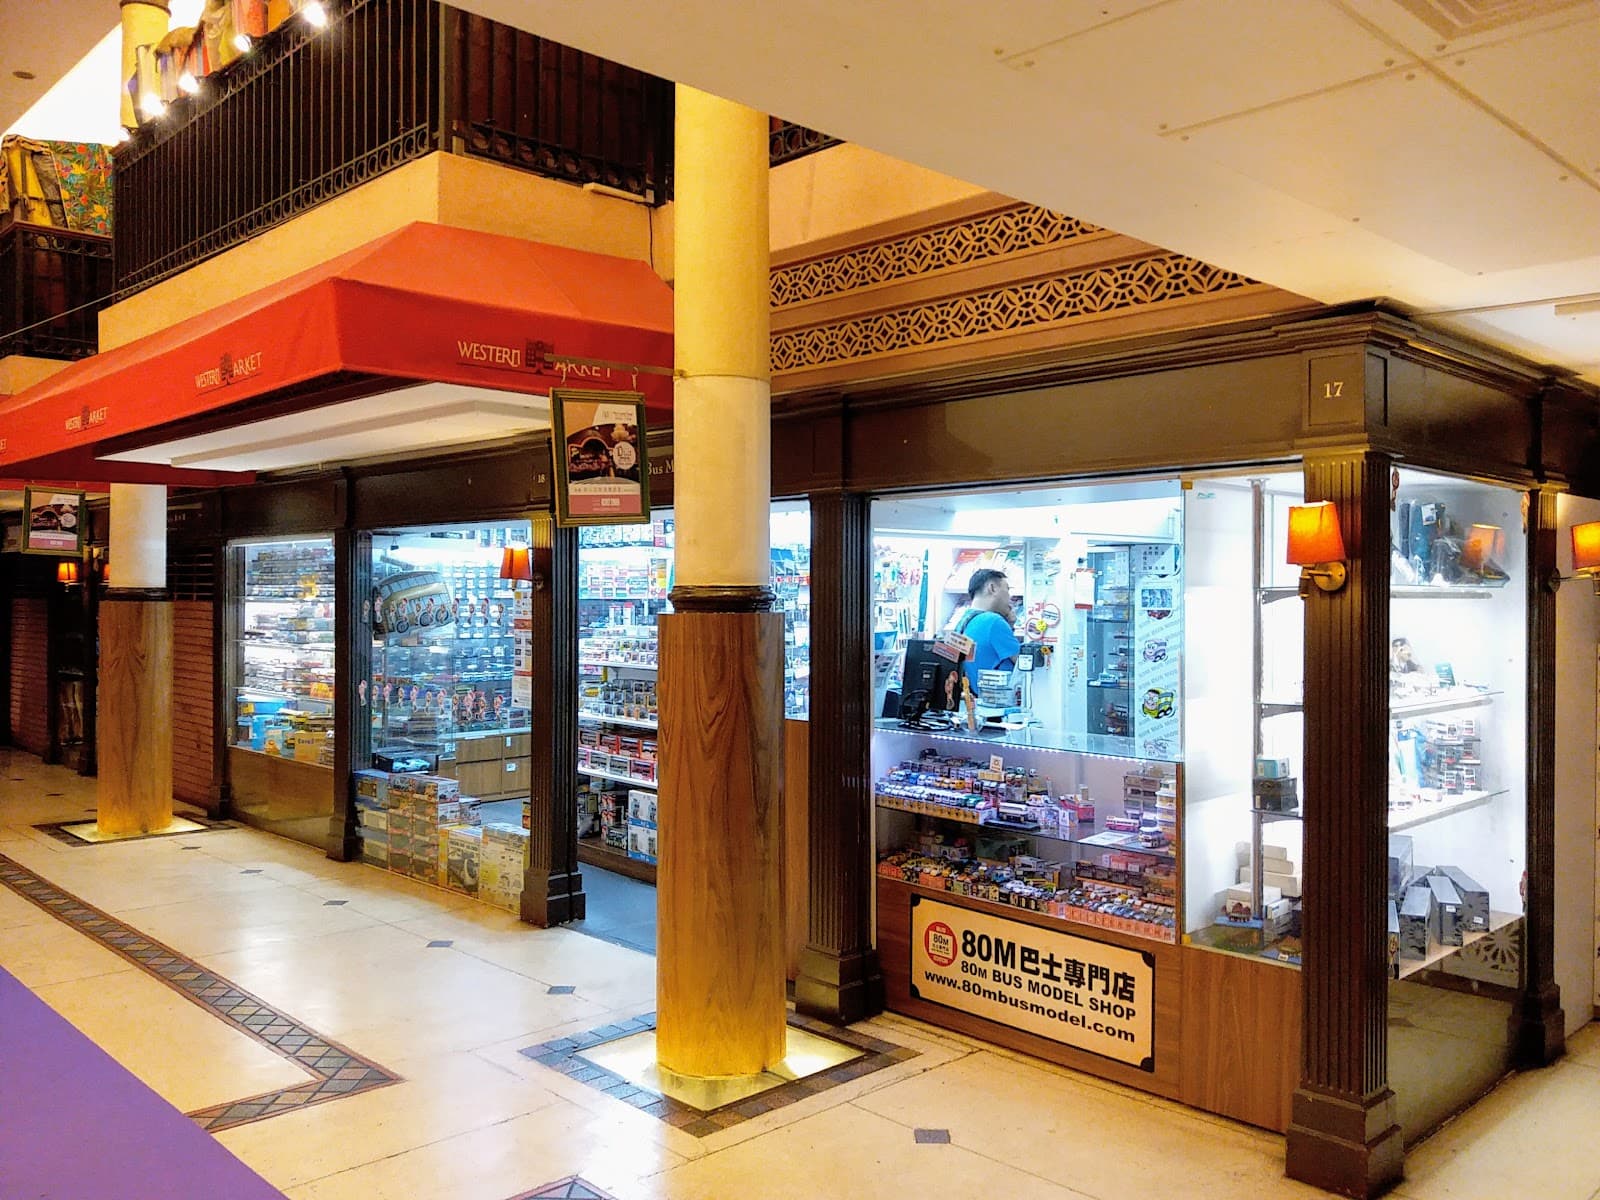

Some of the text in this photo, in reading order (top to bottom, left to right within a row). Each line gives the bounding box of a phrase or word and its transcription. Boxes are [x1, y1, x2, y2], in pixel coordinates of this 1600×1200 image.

[457, 340, 521, 368] WESTERN
[1324, 381, 1344, 399] 17
[924, 970, 1136, 1043] www.80mbusmodel.com
[961, 960, 1136, 1021] 80M BUS MODEL SHOP
